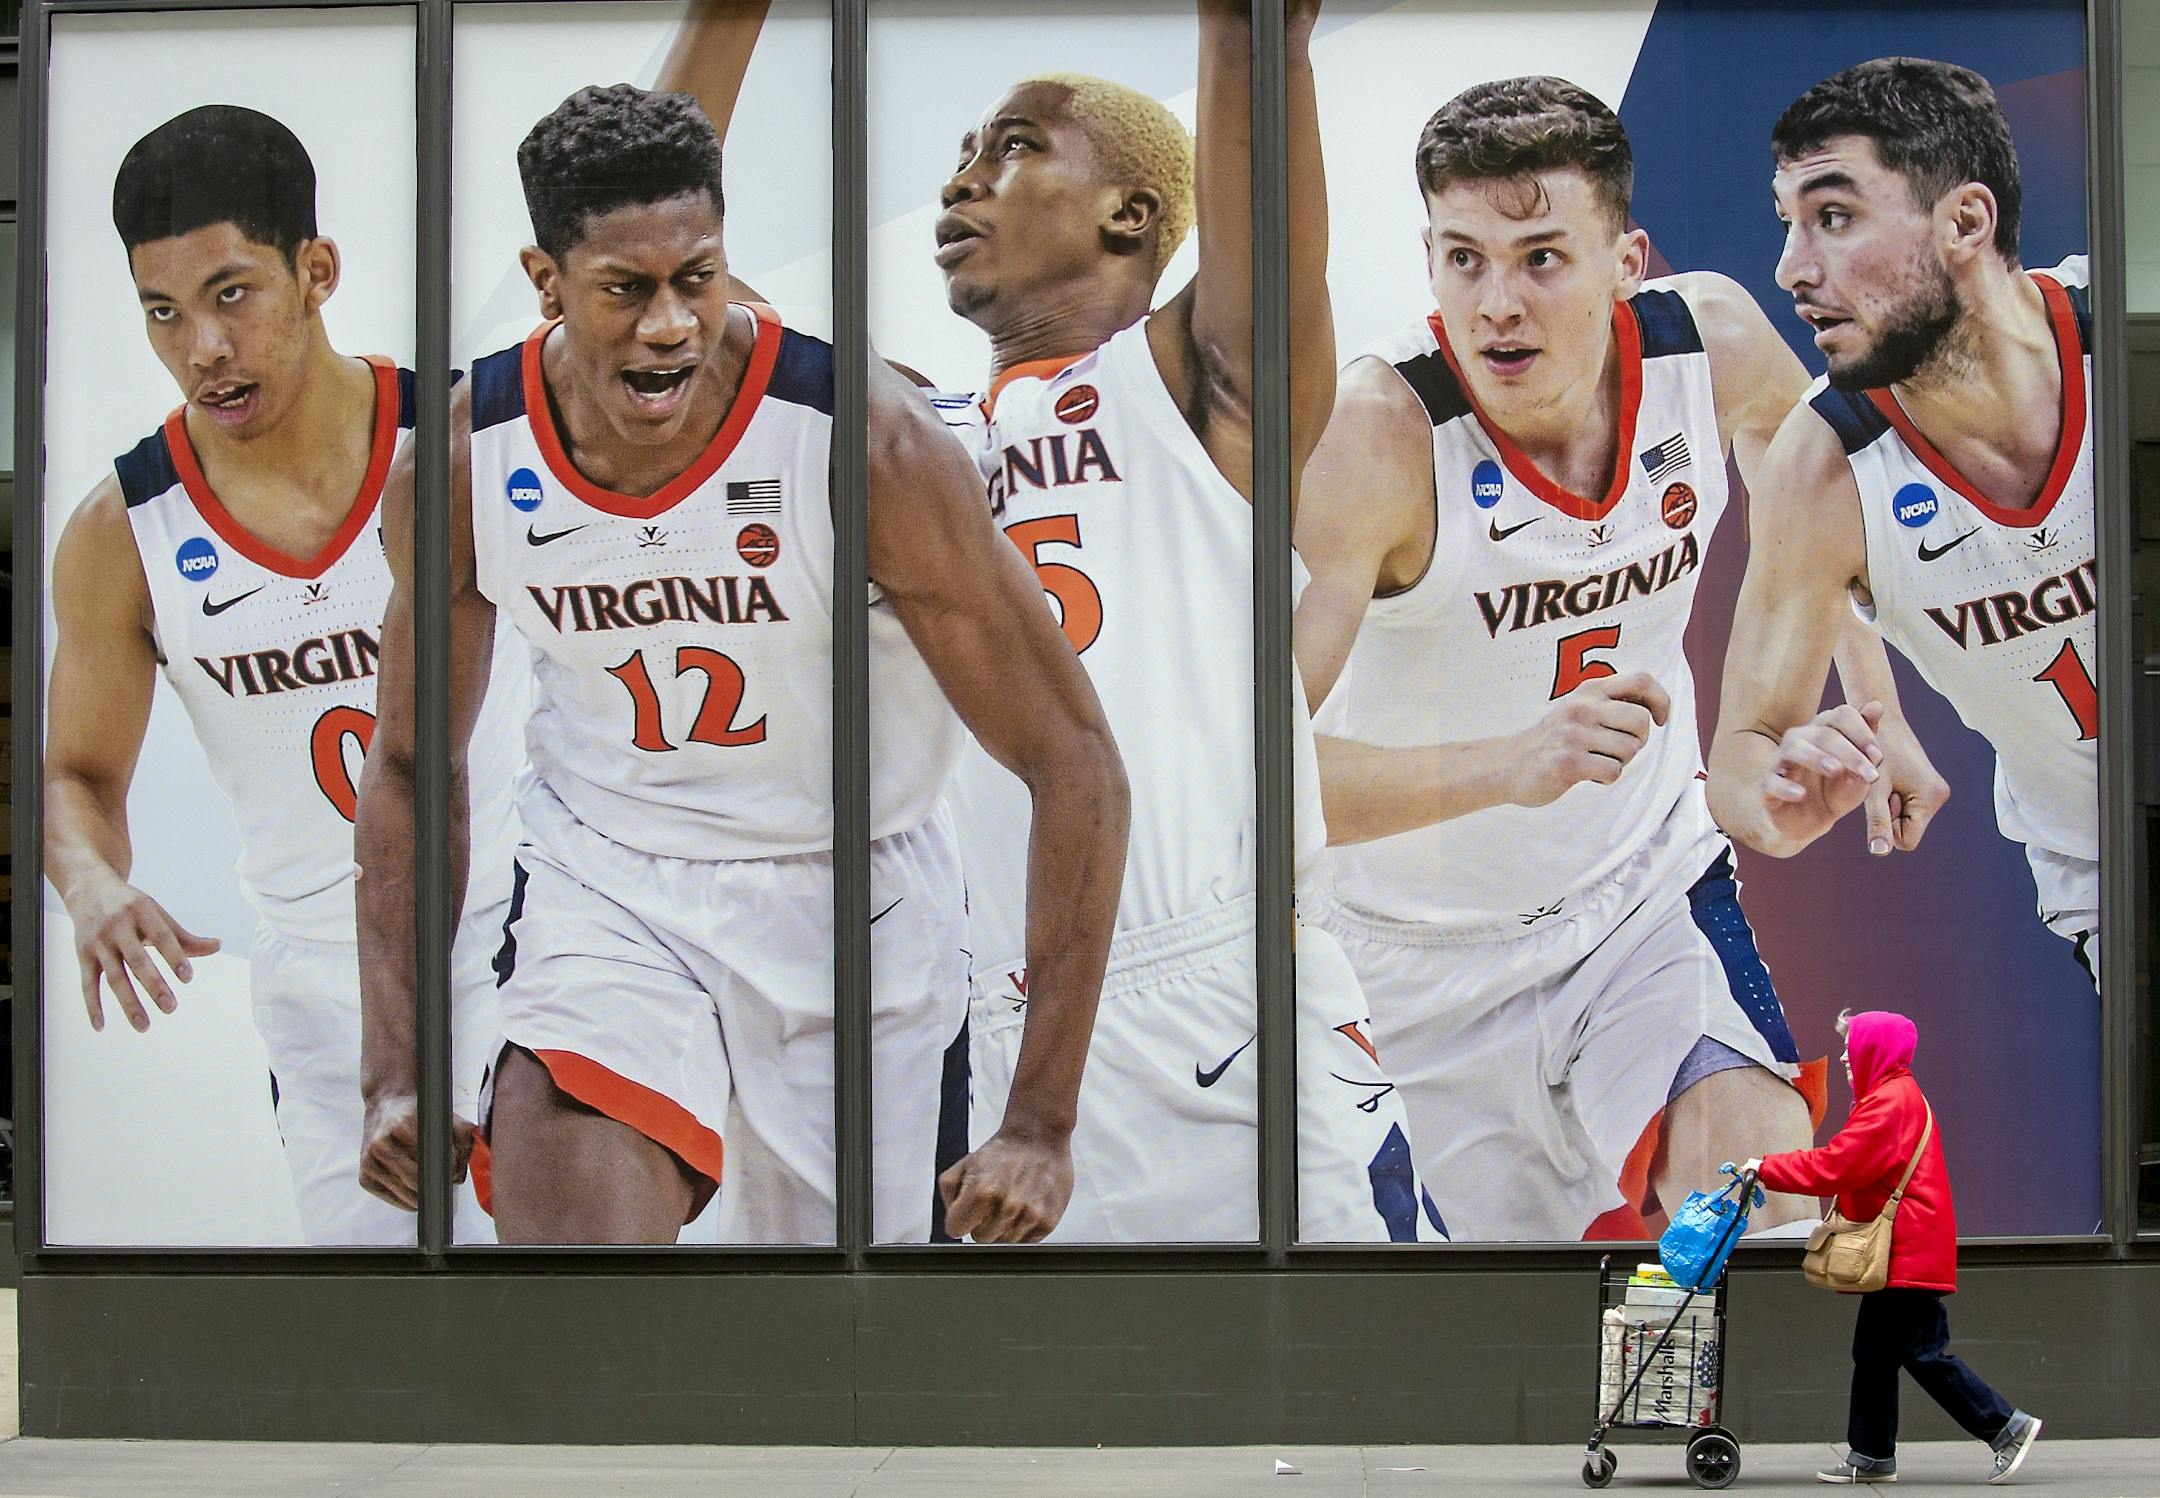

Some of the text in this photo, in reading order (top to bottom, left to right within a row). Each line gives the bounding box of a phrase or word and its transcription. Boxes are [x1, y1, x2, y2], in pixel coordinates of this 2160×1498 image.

[1475, 483, 1502, 497] NCAA
[1900, 499, 1937, 521] NCAA
[182, 554, 217, 573] NCAA
[525, 575, 791, 635] VIRGINIA
[1003, 513, 1103, 656] 5
[1473, 531, 1700, 640] VIRGINIA
[604, 645, 768, 752] 12
[2032, 637, 2097, 741] 1
[1654, 1338, 1676, 1422] Marshalls
